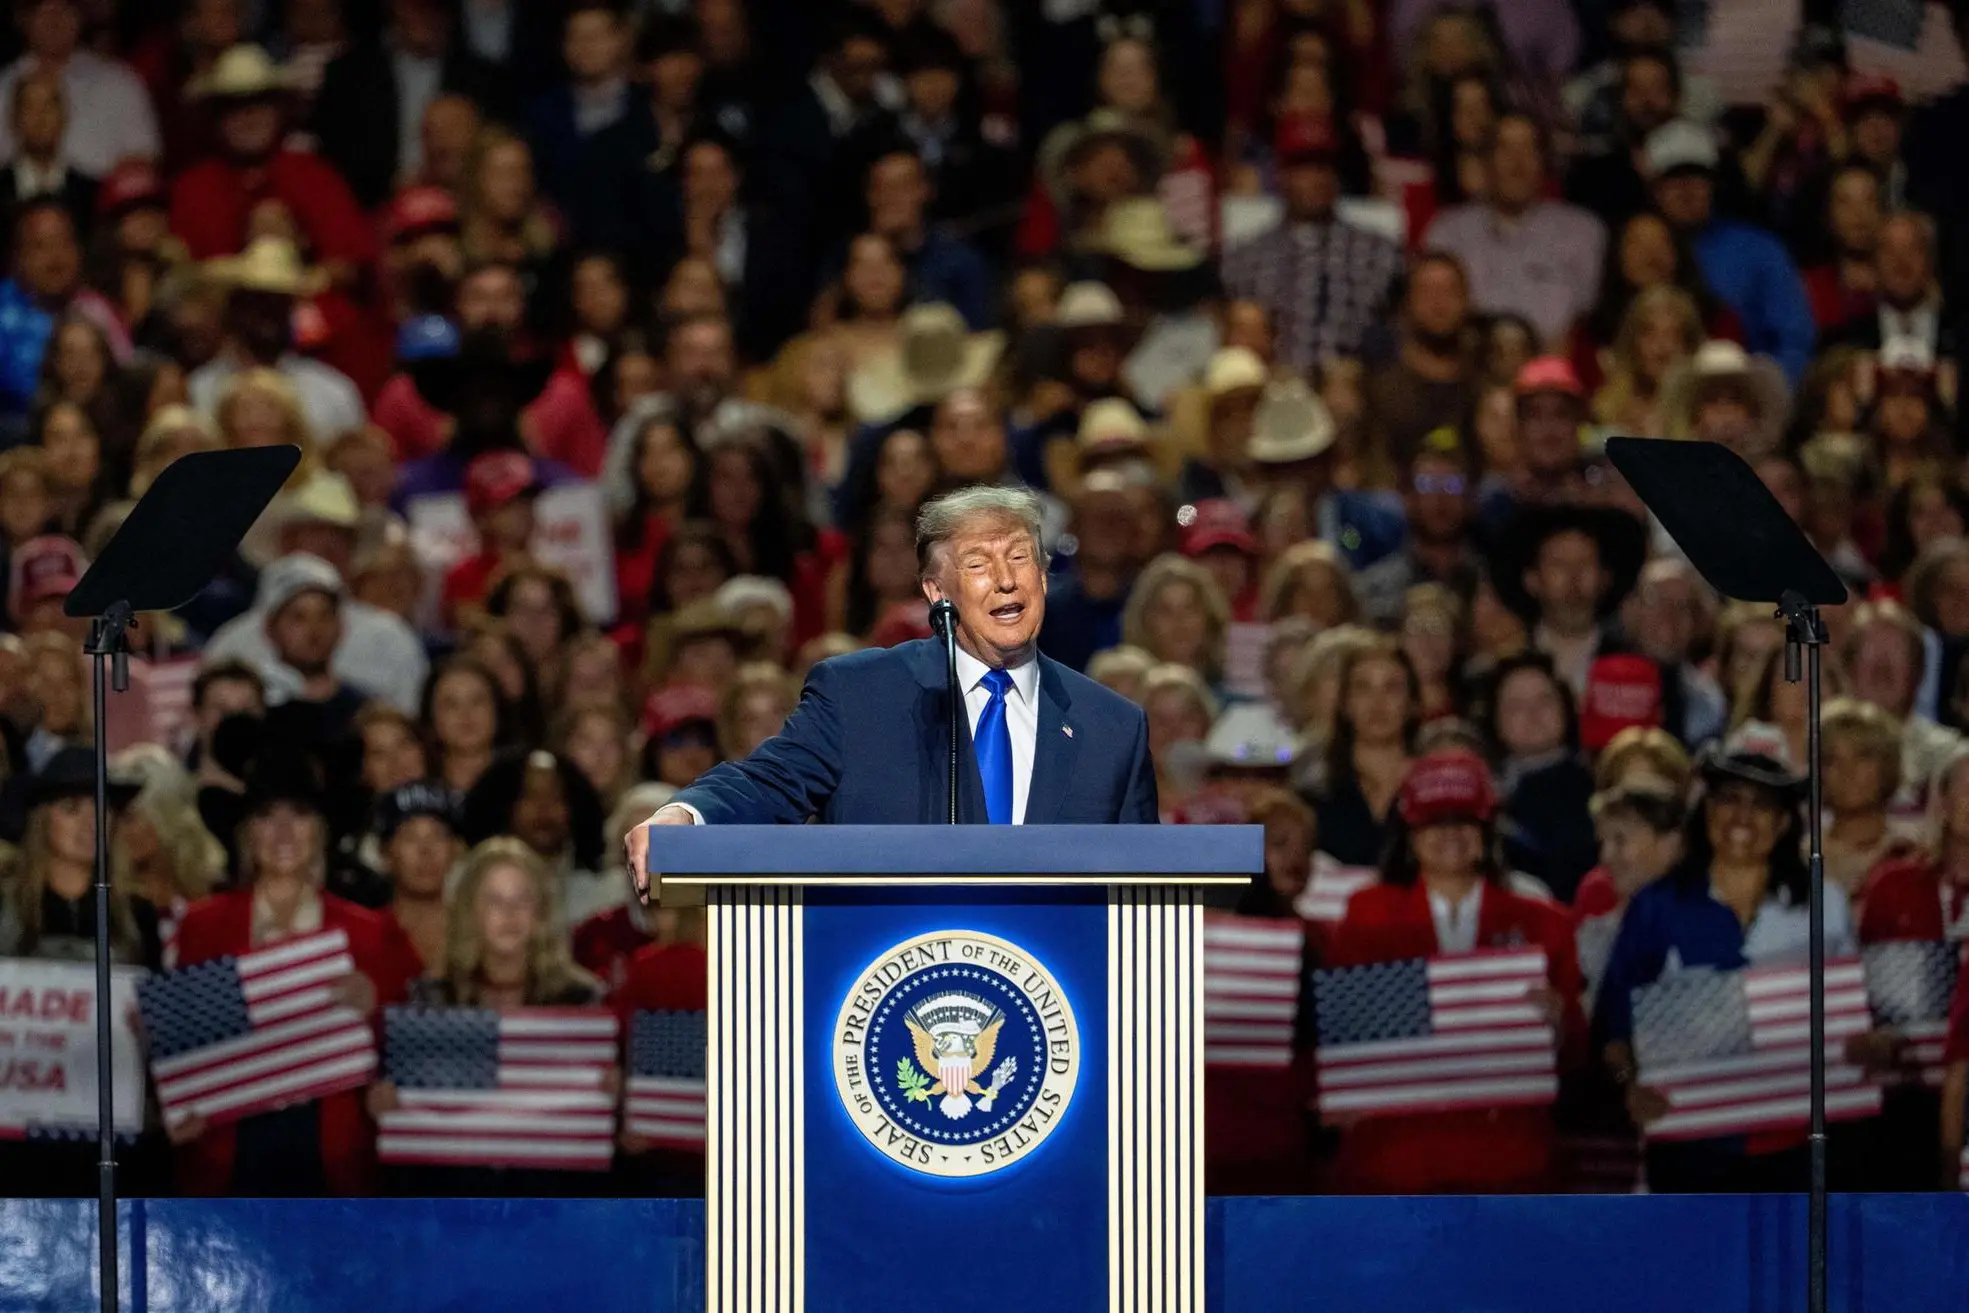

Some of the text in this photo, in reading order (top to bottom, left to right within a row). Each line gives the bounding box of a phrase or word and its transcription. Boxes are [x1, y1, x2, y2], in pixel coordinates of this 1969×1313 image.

[842, 940, 1070, 1164] SEAL OF THE PRESIDENT OF THE UNITED STATES
